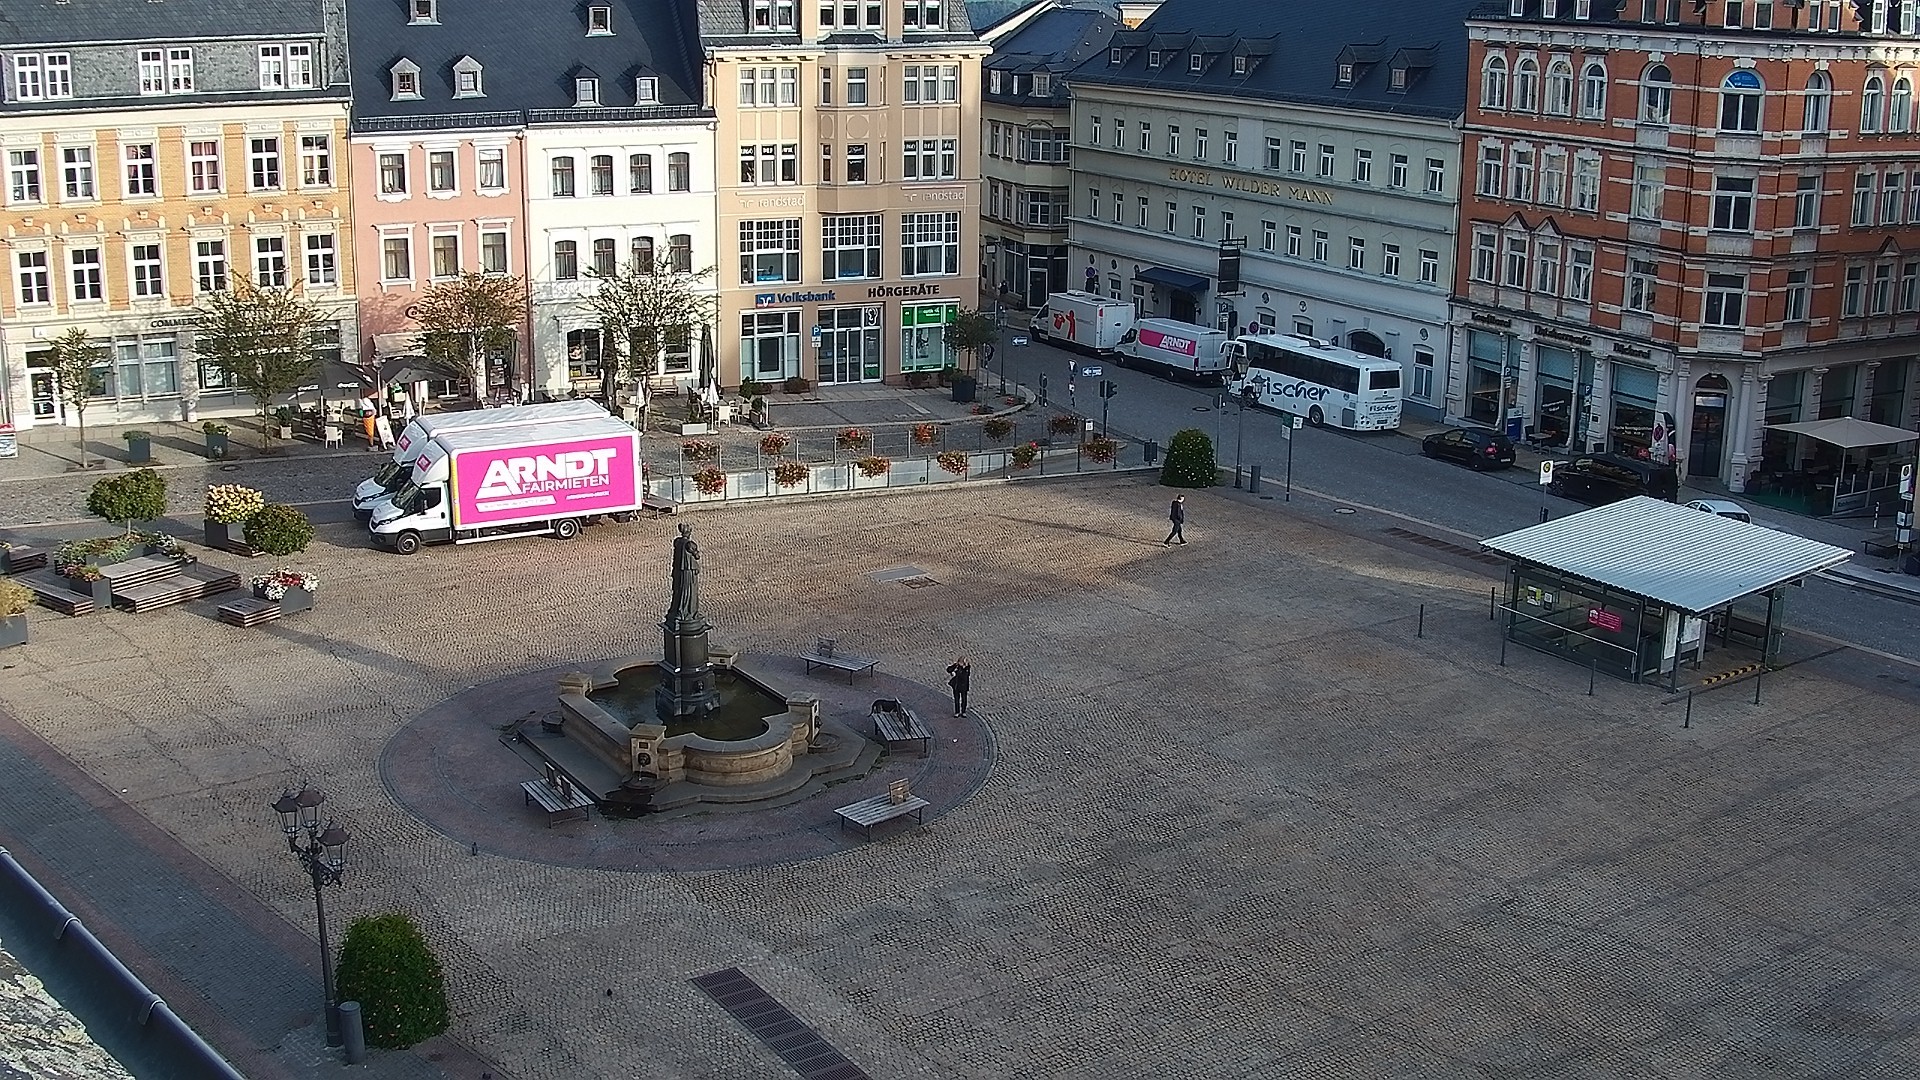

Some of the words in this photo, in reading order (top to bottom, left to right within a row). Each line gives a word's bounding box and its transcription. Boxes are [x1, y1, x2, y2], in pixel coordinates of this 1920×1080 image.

[1168, 167, 1214, 187] HOTEL
[1221, 175, 1281, 198] WILDER
[1288, 185, 1334, 206] MANN
[758, 195, 805, 208] randstad
[921, 189, 966, 201] randstad
[777, 290, 836, 303] Volksbank
[867, 283, 940, 298] HÖRGERÄTE
[1159, 334, 1191, 349] ARNDT
[1260, 375, 1331, 402] ischer
[475, 447, 617, 500] ARNDT
[521, 474, 610, 494] FAIRMIETEN
